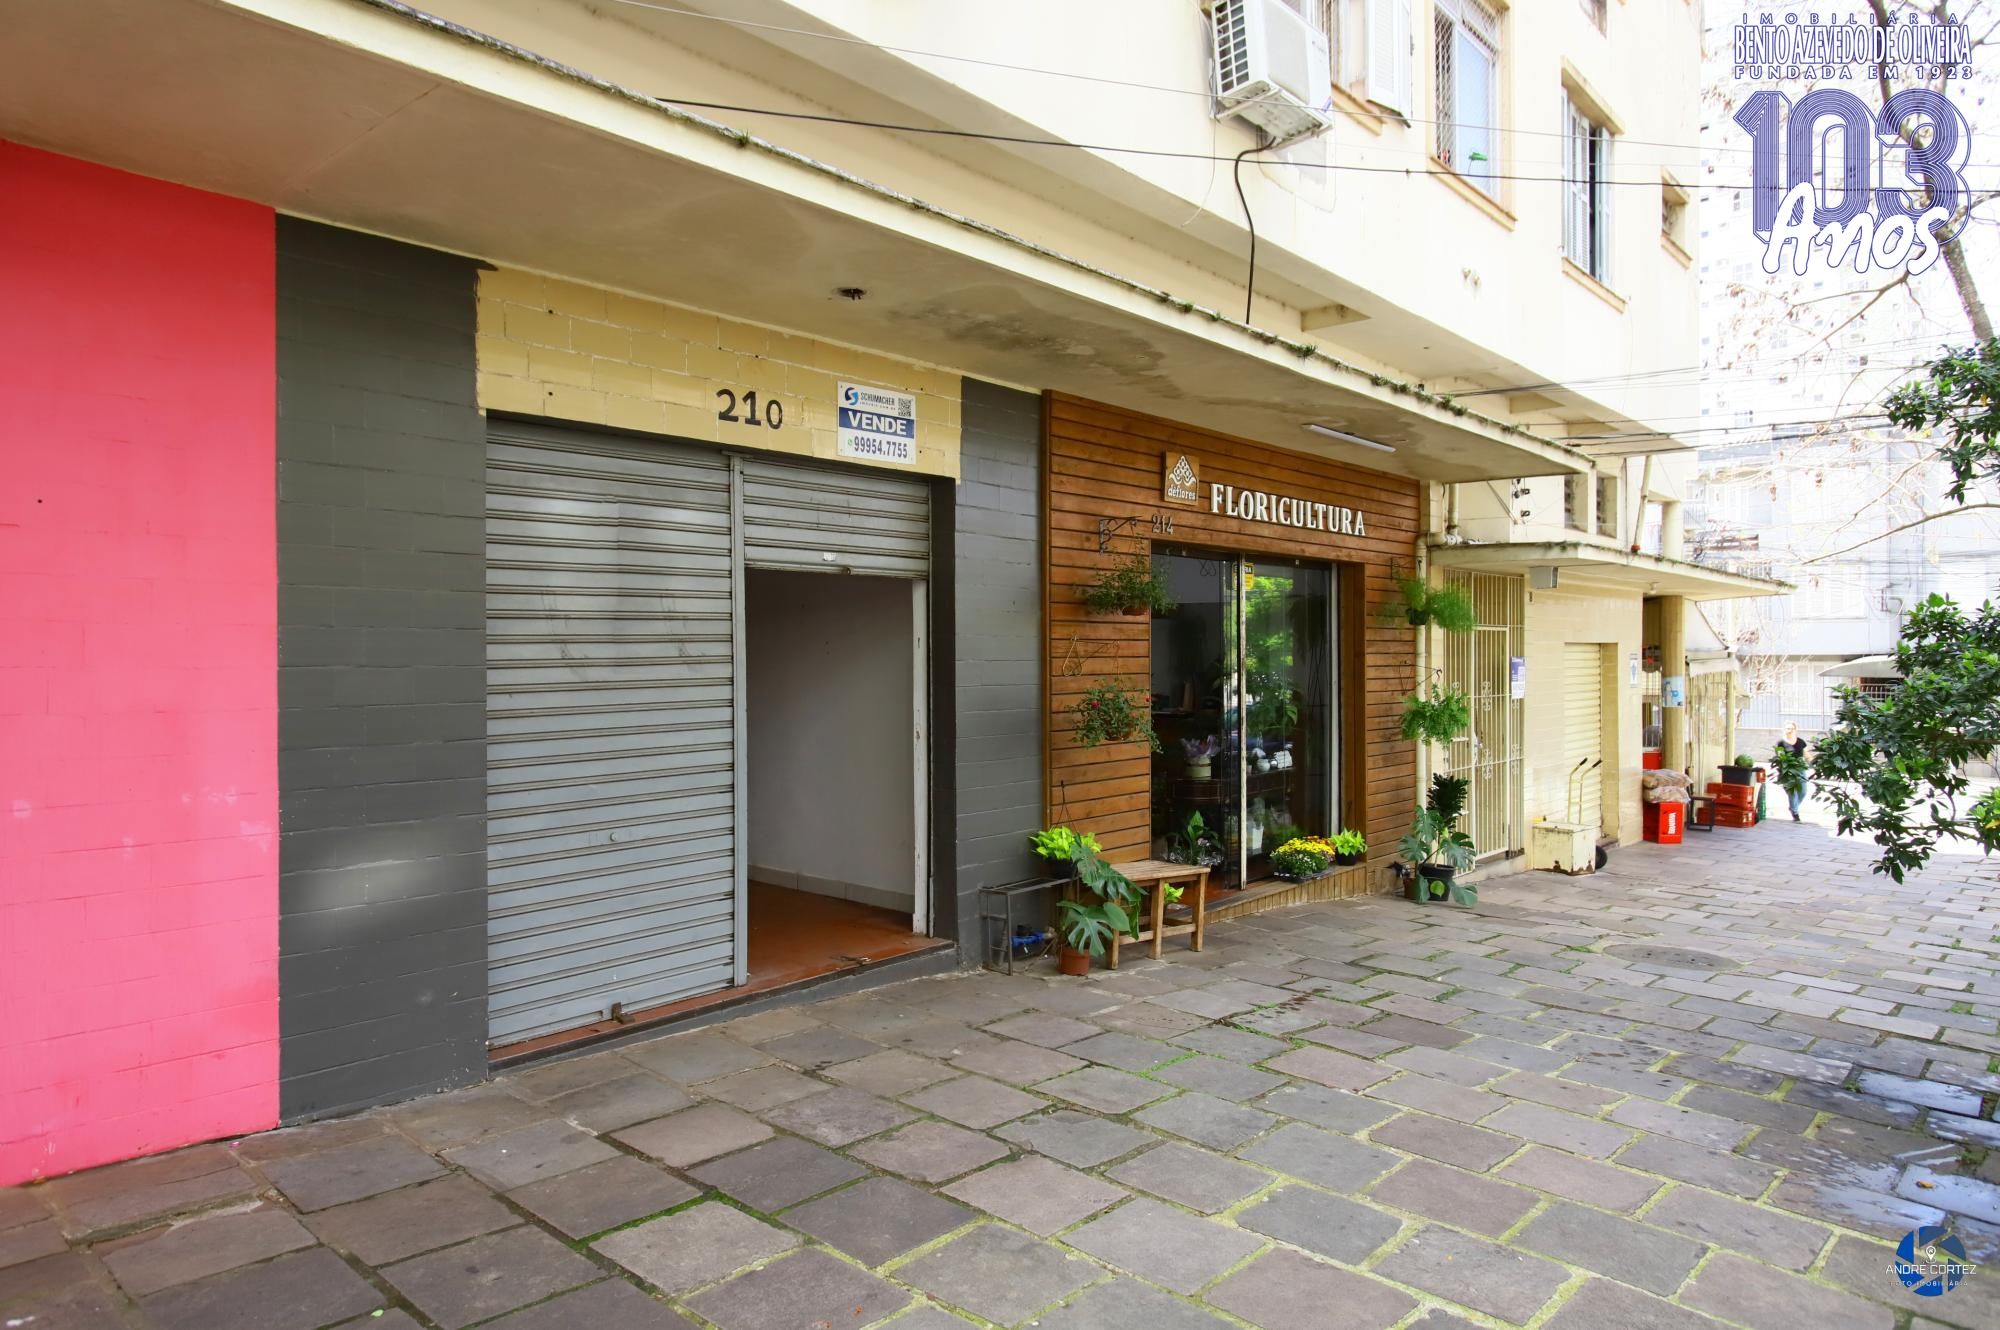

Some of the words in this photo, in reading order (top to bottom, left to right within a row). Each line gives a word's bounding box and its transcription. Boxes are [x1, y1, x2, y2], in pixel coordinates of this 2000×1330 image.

[715, 388, 783, 430] 210
[861, 391, 896, 407] SCHUMACHER
[848, 410, 907, 436] VENDE
[854, 435, 908, 459] 99954.7755
[1210, 483, 1366, 536] FLORICULTURA
[1152, 515, 1174, 535] 214
